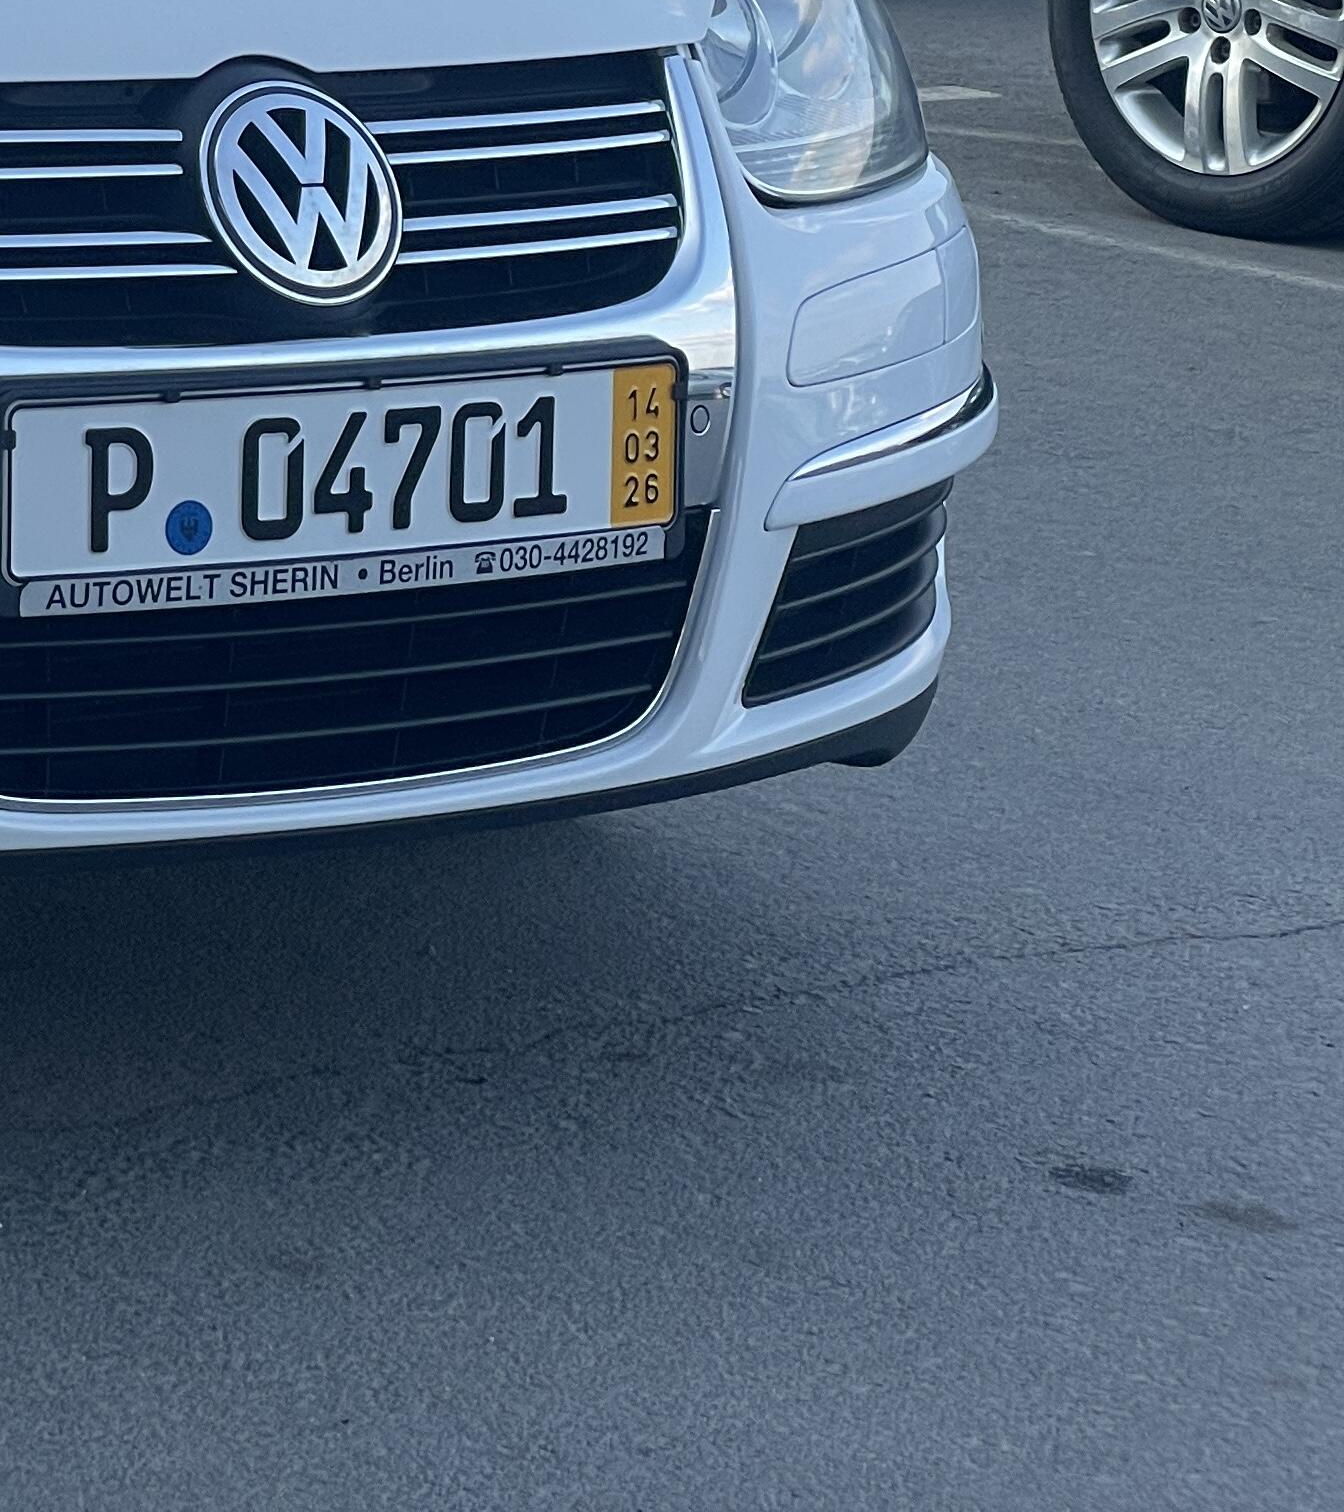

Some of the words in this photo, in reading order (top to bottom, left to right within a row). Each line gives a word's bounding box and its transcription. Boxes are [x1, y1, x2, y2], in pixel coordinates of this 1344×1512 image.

[628, 387, 659, 421] 14
[625, 430, 659, 464] 03
[85, 426, 154, 553] P
[241, 395, 568, 541] 04701
[624, 473, 659, 508] 26
[45, 573, 222, 611] AUTOWELT
[229, 564, 339, 598] SHERIN
[379, 555, 454, 585] Berlin
[499, 531, 649, 572] 030-4428192
